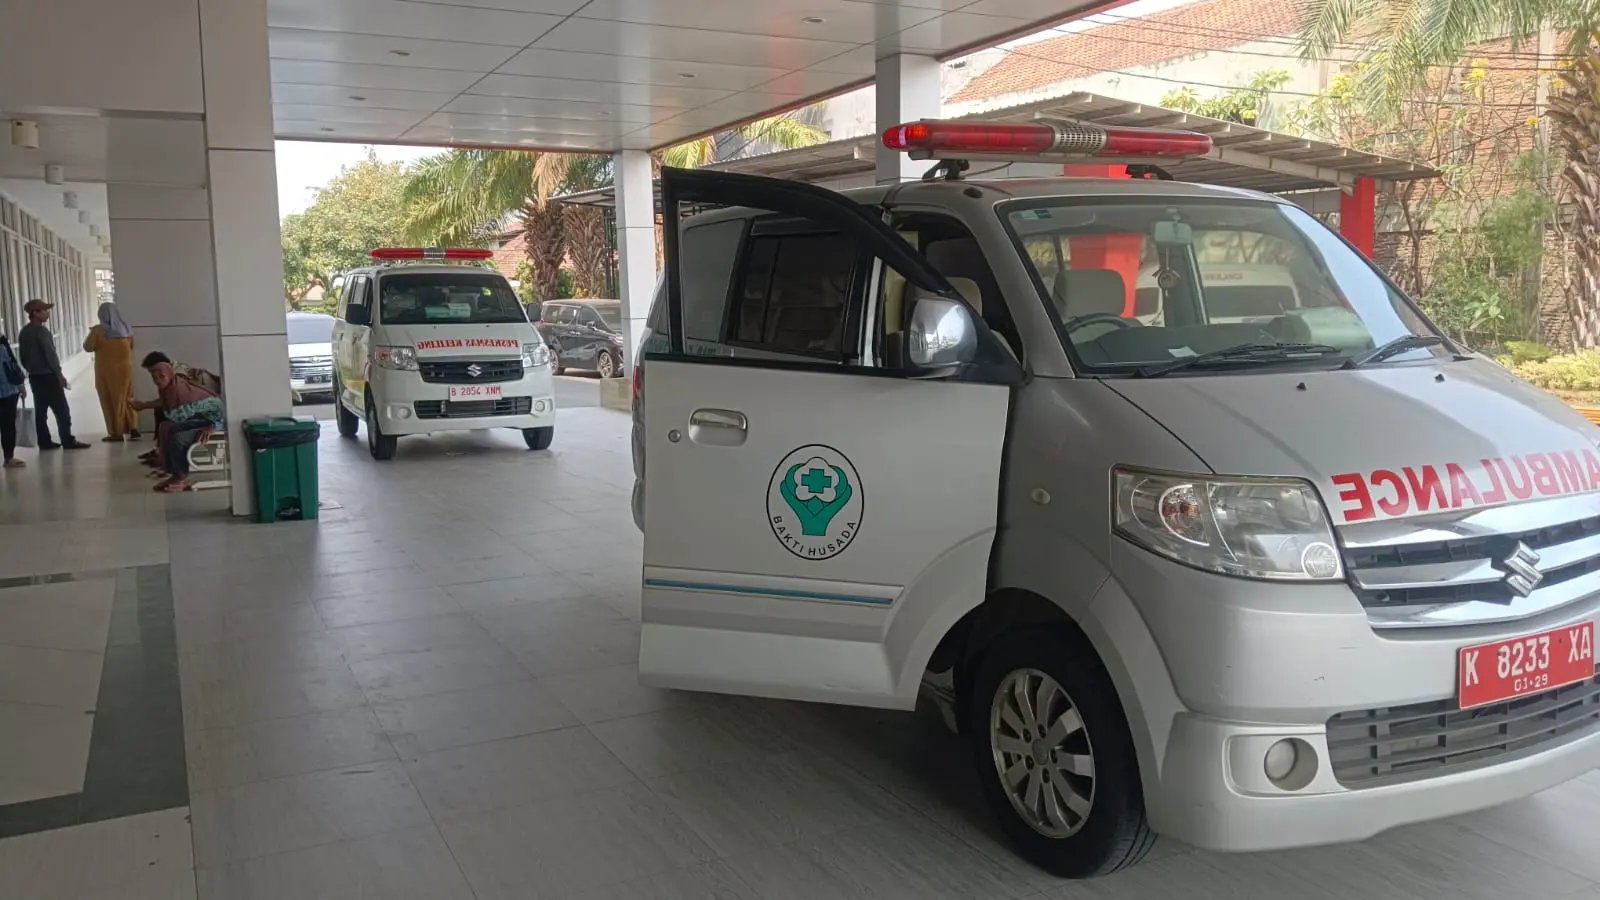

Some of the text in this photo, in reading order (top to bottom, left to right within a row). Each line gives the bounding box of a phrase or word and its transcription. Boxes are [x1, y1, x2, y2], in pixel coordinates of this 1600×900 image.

[451, 387, 457, 396] B
[486, 386, 501, 395] XNM
[773, 515, 857, 556] BAKTI HUSADA
[1465, 626, 1591, 687] K 8233 XA
